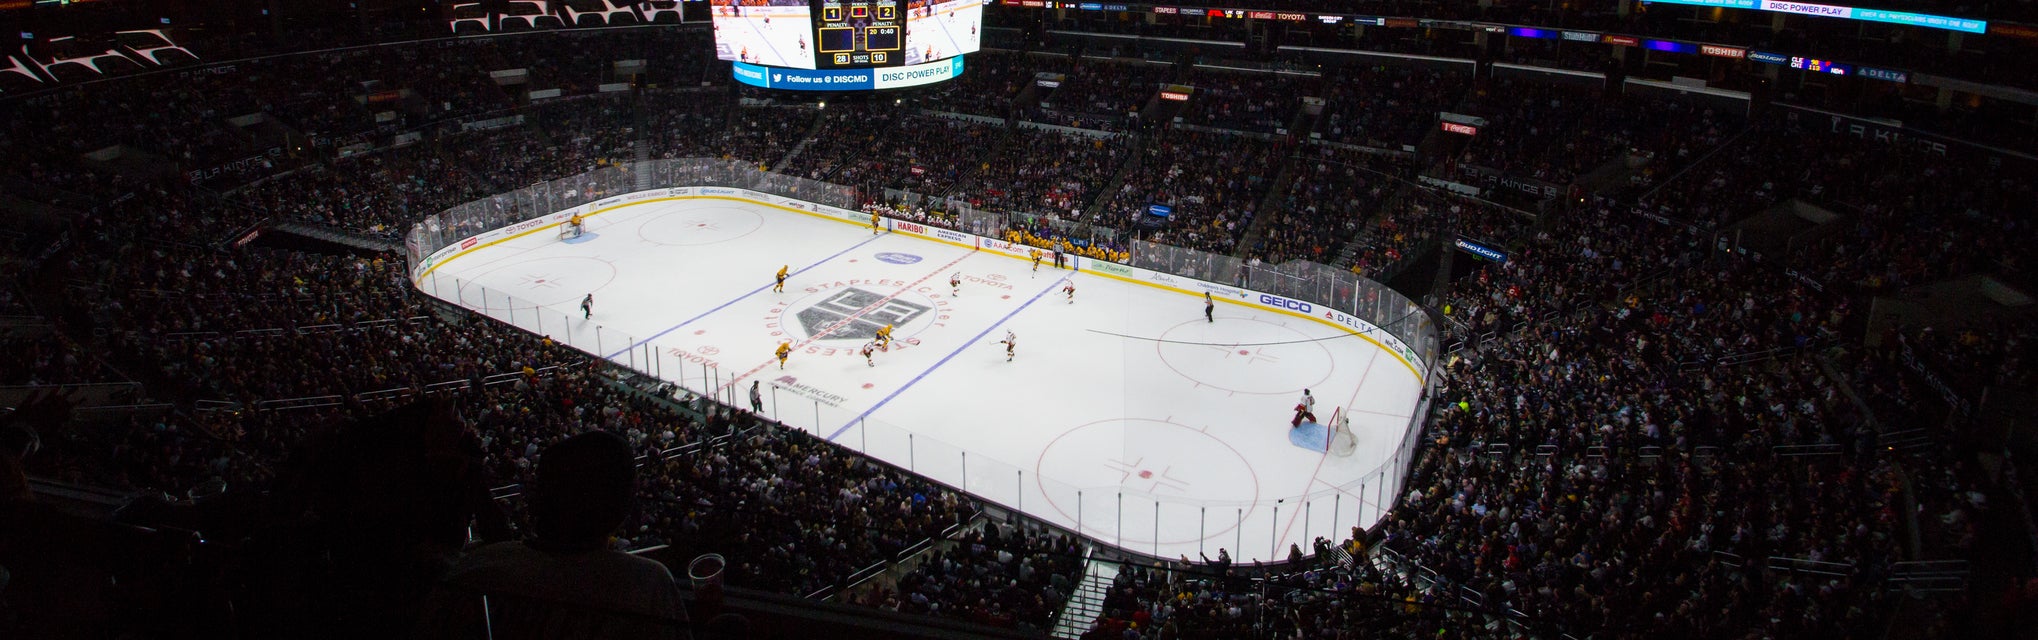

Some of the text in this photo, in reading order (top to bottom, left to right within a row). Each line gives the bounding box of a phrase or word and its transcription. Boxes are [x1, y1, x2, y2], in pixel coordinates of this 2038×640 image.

[830, 9, 836, 18] 1
[884, 8, 890, 16] 2
[1770, 2, 1843, 16] DISC POWER PLAY
[1278, 13, 1306, 21] TOYOTA
[1703, 47, 1744, 58] TOSHIBA
[787, 75, 812, 83] Follow
[833, 75, 868, 83] DISCMD
[882, 66, 950, 81] DISC POWER PLAY
[1869, 70, 1905, 80] DELTA
[1161, 92, 1188, 101] TOSHIBA
[1501, 178, 1539, 194] KINGS
[517, 219, 544, 231] TOYOTA
[897, 221, 924, 234] HARIBO
[937, 229, 967, 239] AMERICAN
[1459, 241, 1477, 251] BUD
[1477, 247, 1503, 259] LIGHT
[963, 274, 1013, 290] TOYOTA
[804, 278, 953, 329] STAPLES Center
[1259, 294, 1312, 314] GEICO
[1337, 313, 1373, 335] DELTA
[1385, 339, 1404, 355] NHL.COM
[667, 347, 719, 369] TOYOTA
[793, 382, 849, 404] MERCURY
